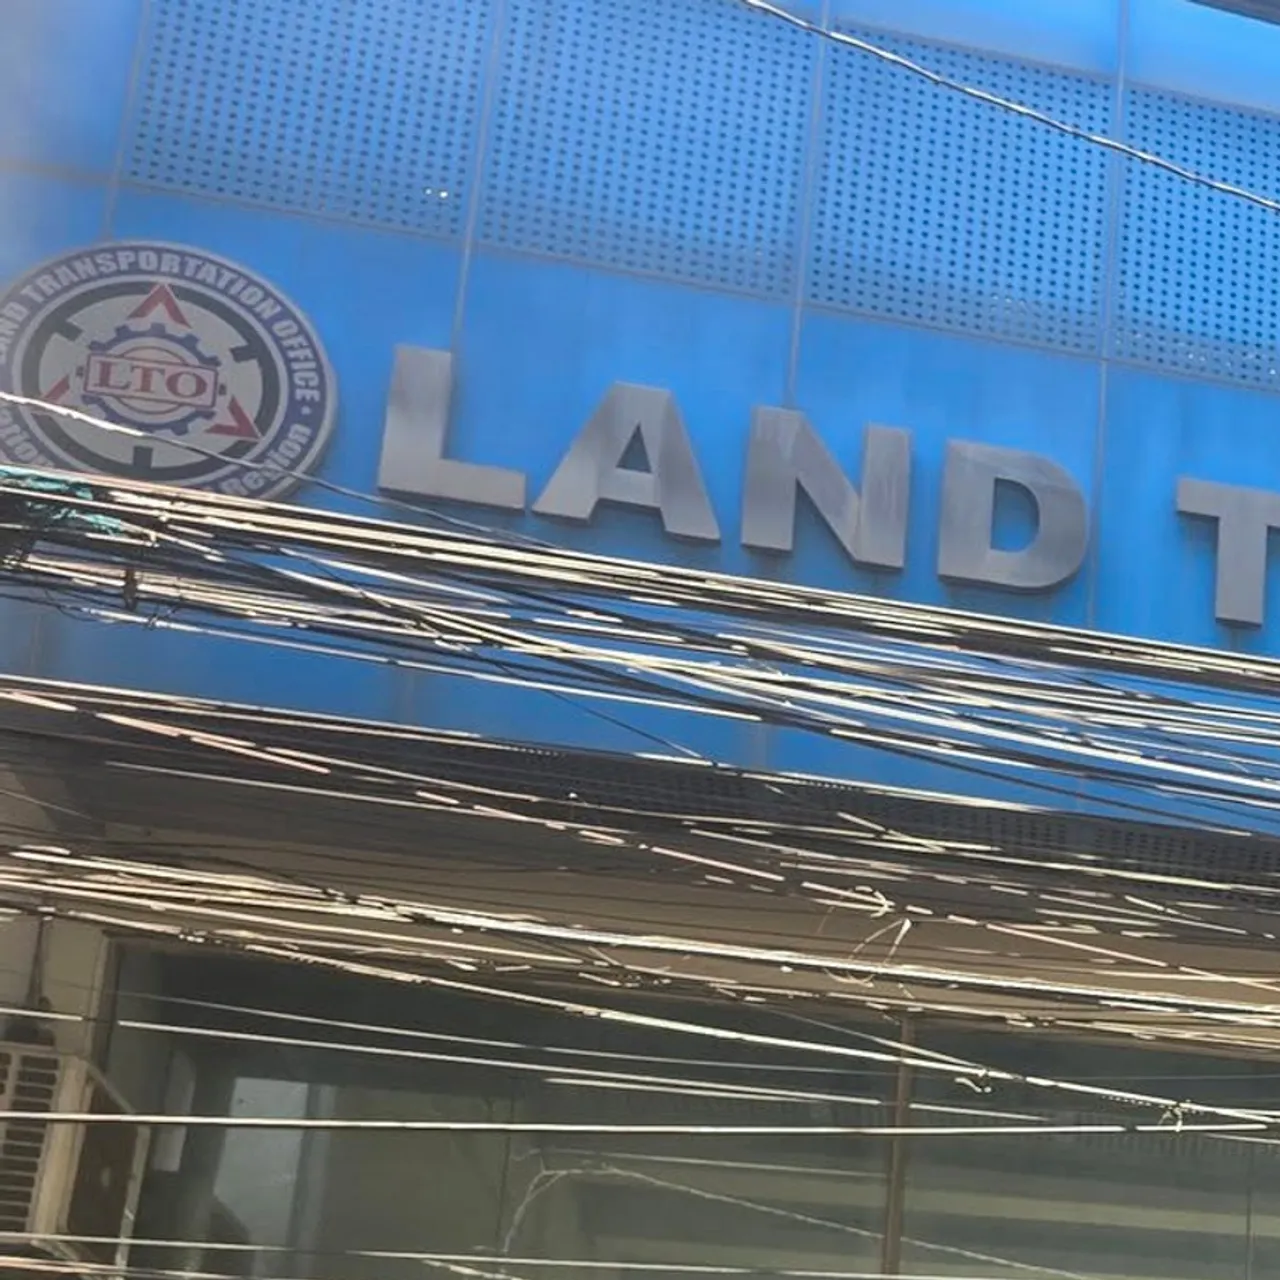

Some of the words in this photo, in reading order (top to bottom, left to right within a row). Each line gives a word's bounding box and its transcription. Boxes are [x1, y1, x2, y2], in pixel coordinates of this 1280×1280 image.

[21, 250, 282, 320] TRANSPORTATION
[272, 317, 321, 402] OFFICE
[97, 361, 208, 399] LTO
[377, 342, 1089, 591] LAND
